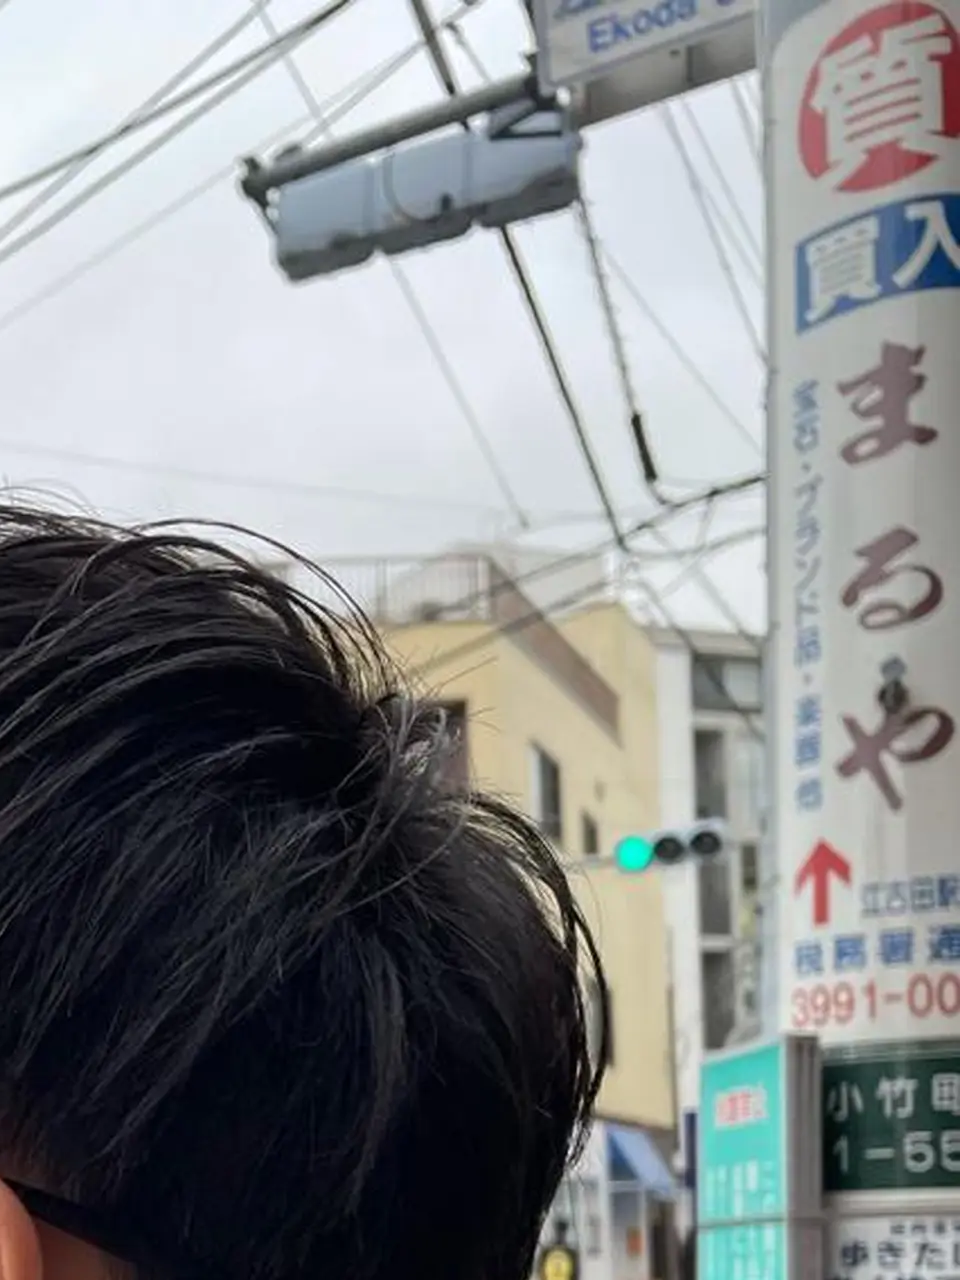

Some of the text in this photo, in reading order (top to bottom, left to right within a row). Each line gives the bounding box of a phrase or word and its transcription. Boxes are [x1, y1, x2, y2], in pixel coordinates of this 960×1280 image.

[808, 11, 960, 192] 質
[806, 200, 960, 323] 買入
[836, 339, 955, 812] まるや
[791, 972, 960, 1028] 3991-00
